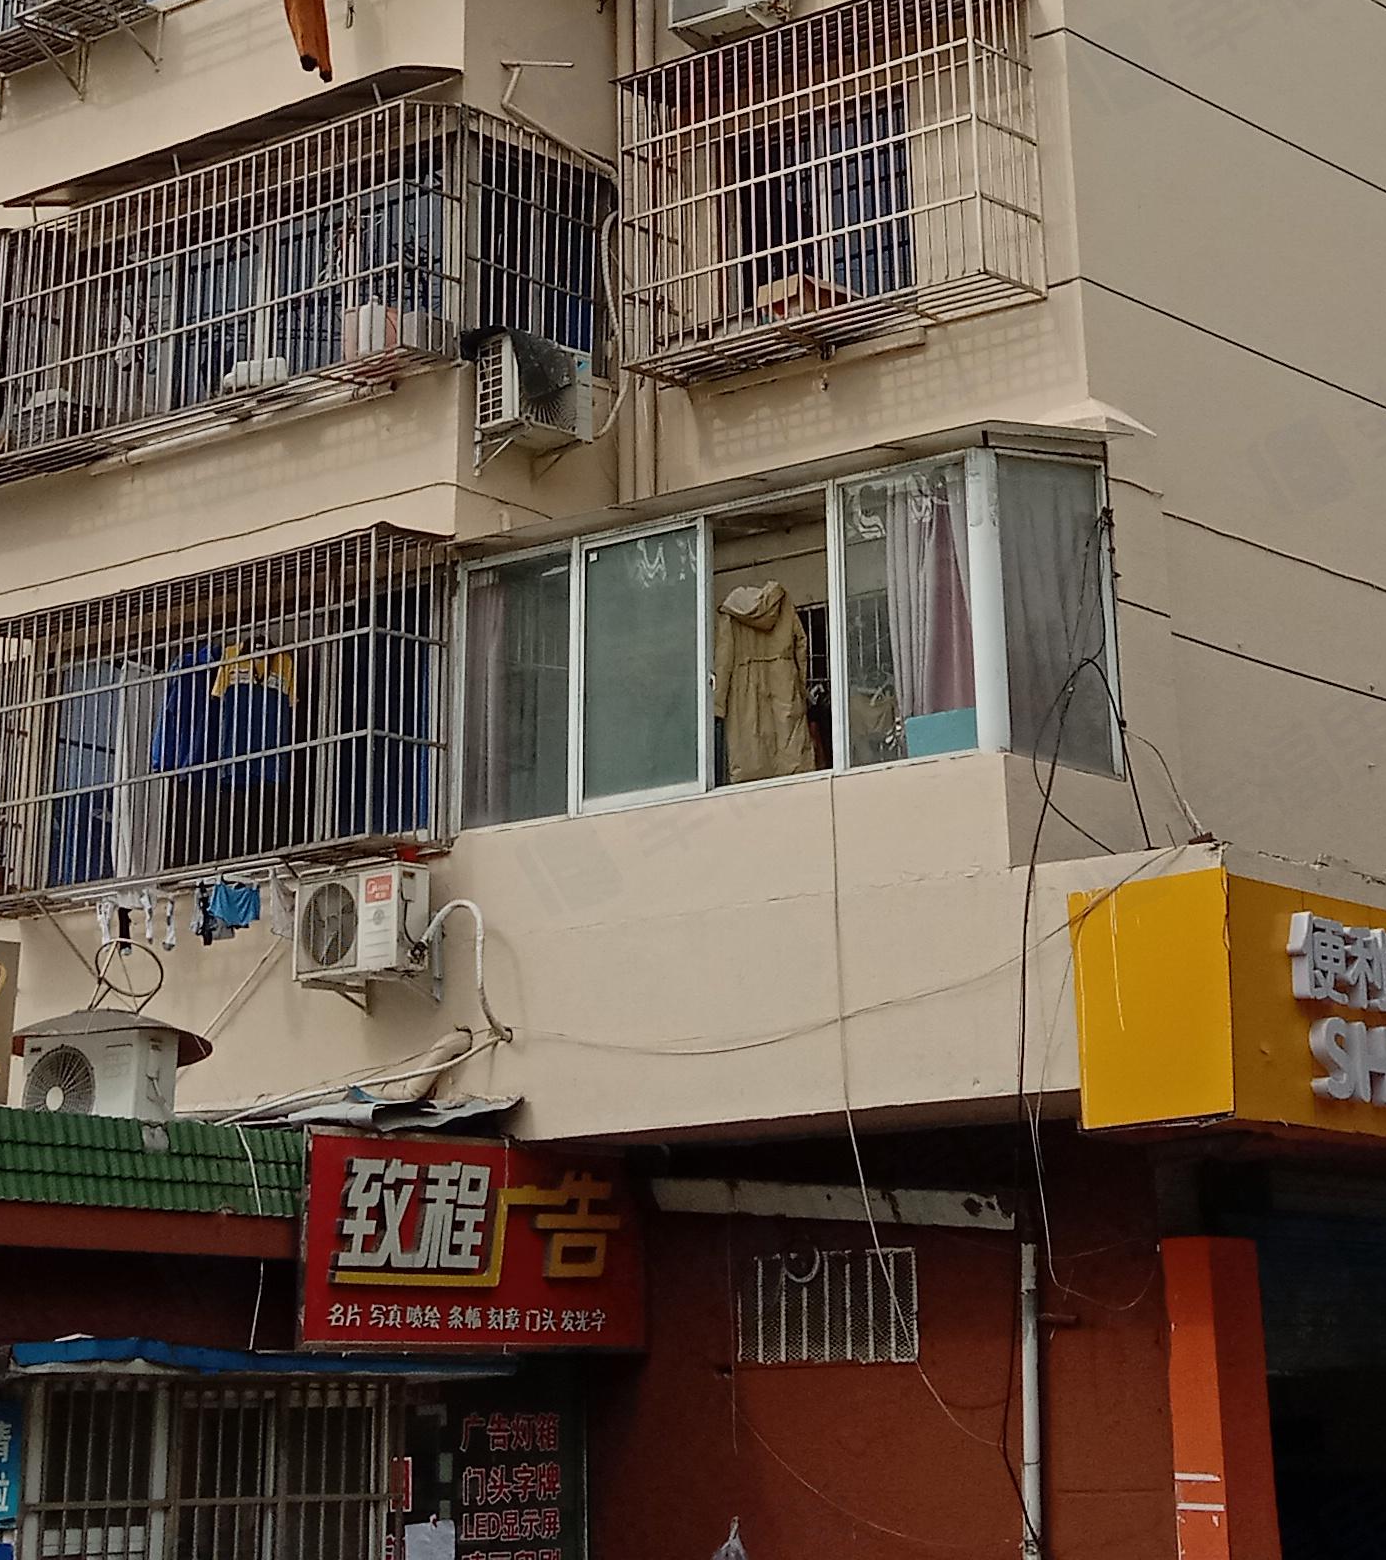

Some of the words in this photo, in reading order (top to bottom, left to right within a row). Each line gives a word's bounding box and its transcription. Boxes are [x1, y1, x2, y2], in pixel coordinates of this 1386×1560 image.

[331, 1158, 621, 1287] 致程广告
[327, 1303, 363, 1328] 名片
[368, 1304, 403, 1329] 写真
[406, 1304, 441, 1330] 喷绘
[447, 1305, 483, 1330] 条幅
[487, 1306, 521, 1332] 刻章
[525, 1308, 558, 1332] 门头
[561, 1309, 606, 1333] 发光字
[459, 1412, 560, 1452] 广告灯箱
[461, 1462, 562, 1506] 门头字牌
[460, 1507, 561, 1542] LED显示屏
